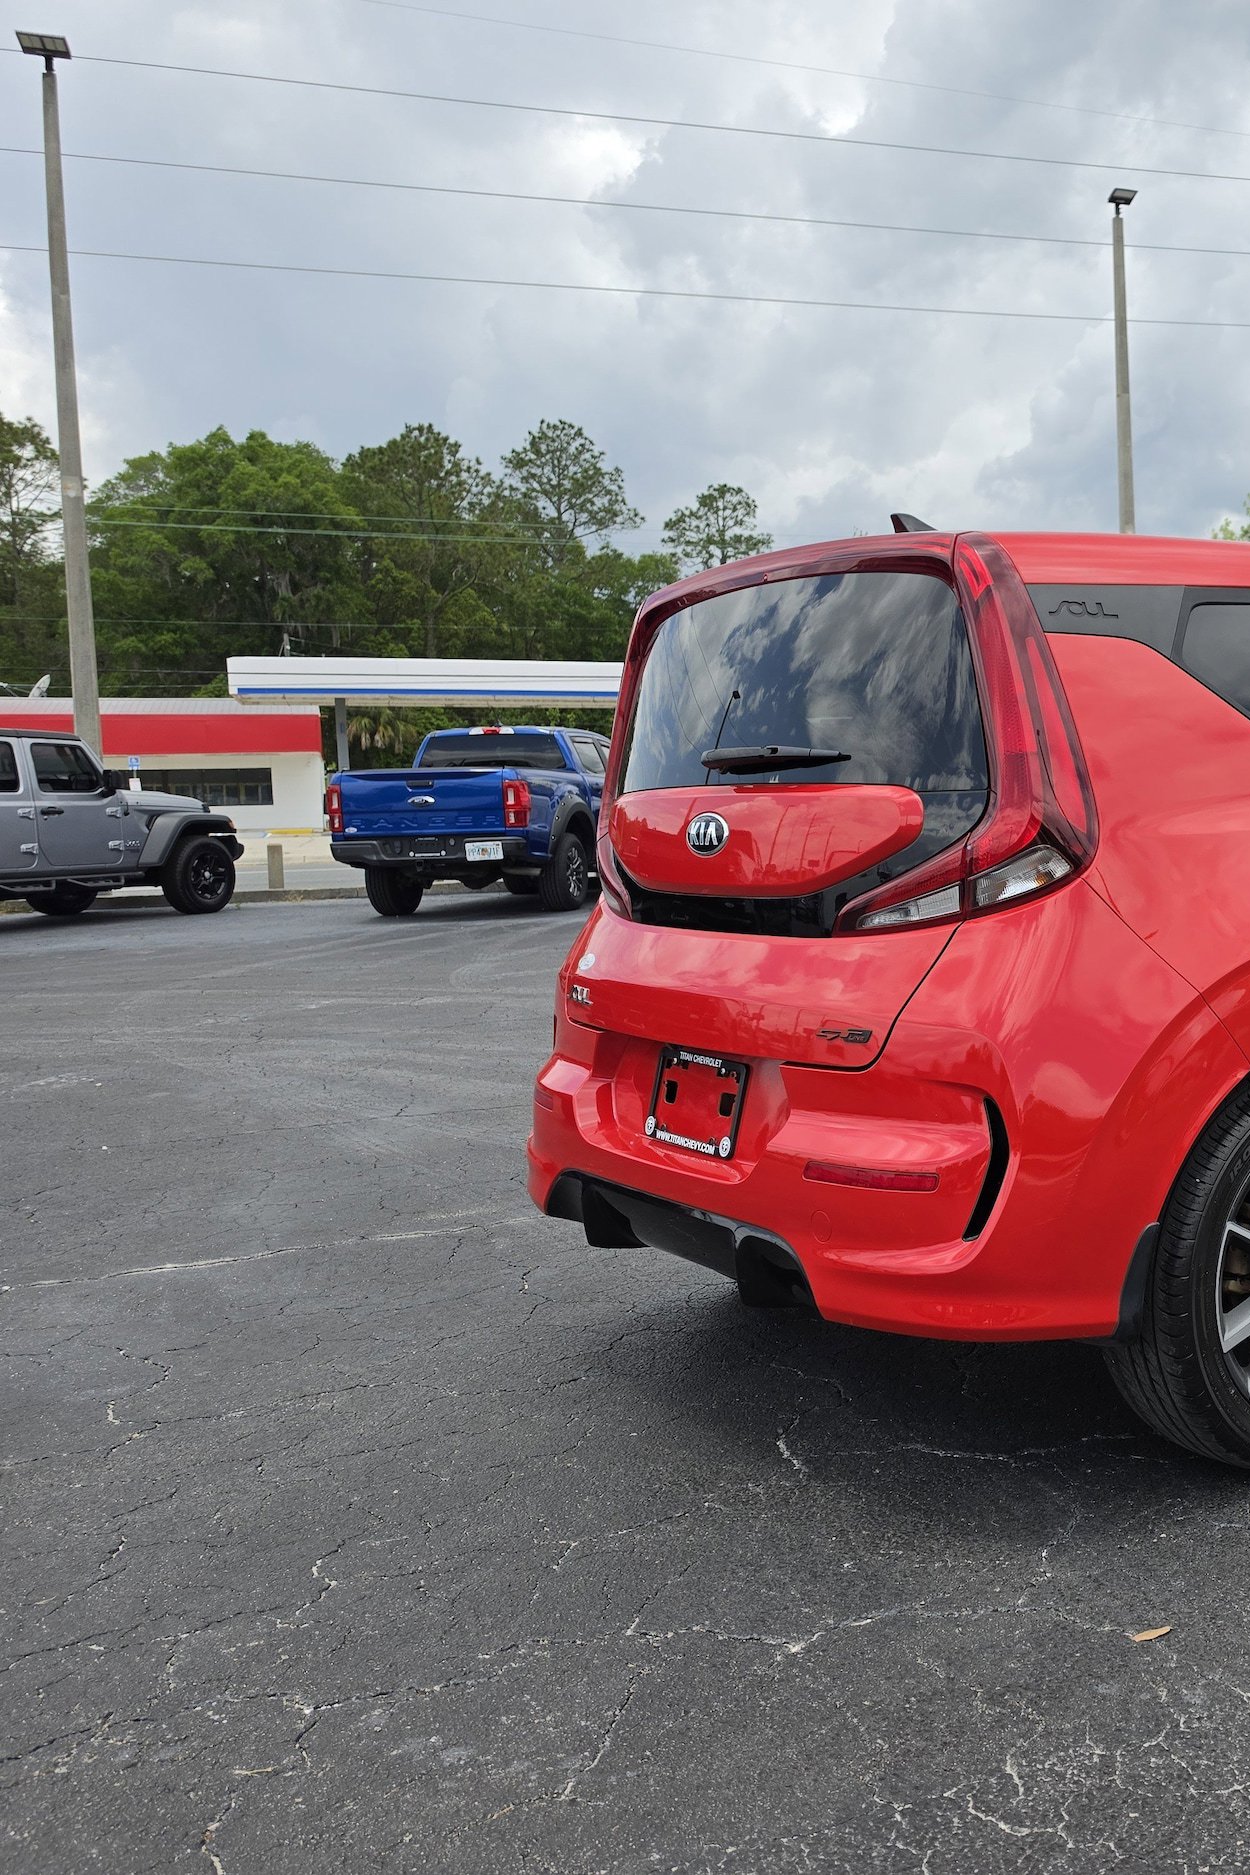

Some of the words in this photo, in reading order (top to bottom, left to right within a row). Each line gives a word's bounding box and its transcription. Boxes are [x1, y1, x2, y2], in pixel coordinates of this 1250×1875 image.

[351, 815, 500, 829] RANGER
[689, 821, 719, 846] KIA
[679, 1051, 695, 1063] TITAN
[693, 1054, 723, 1068] CHEVROLET
